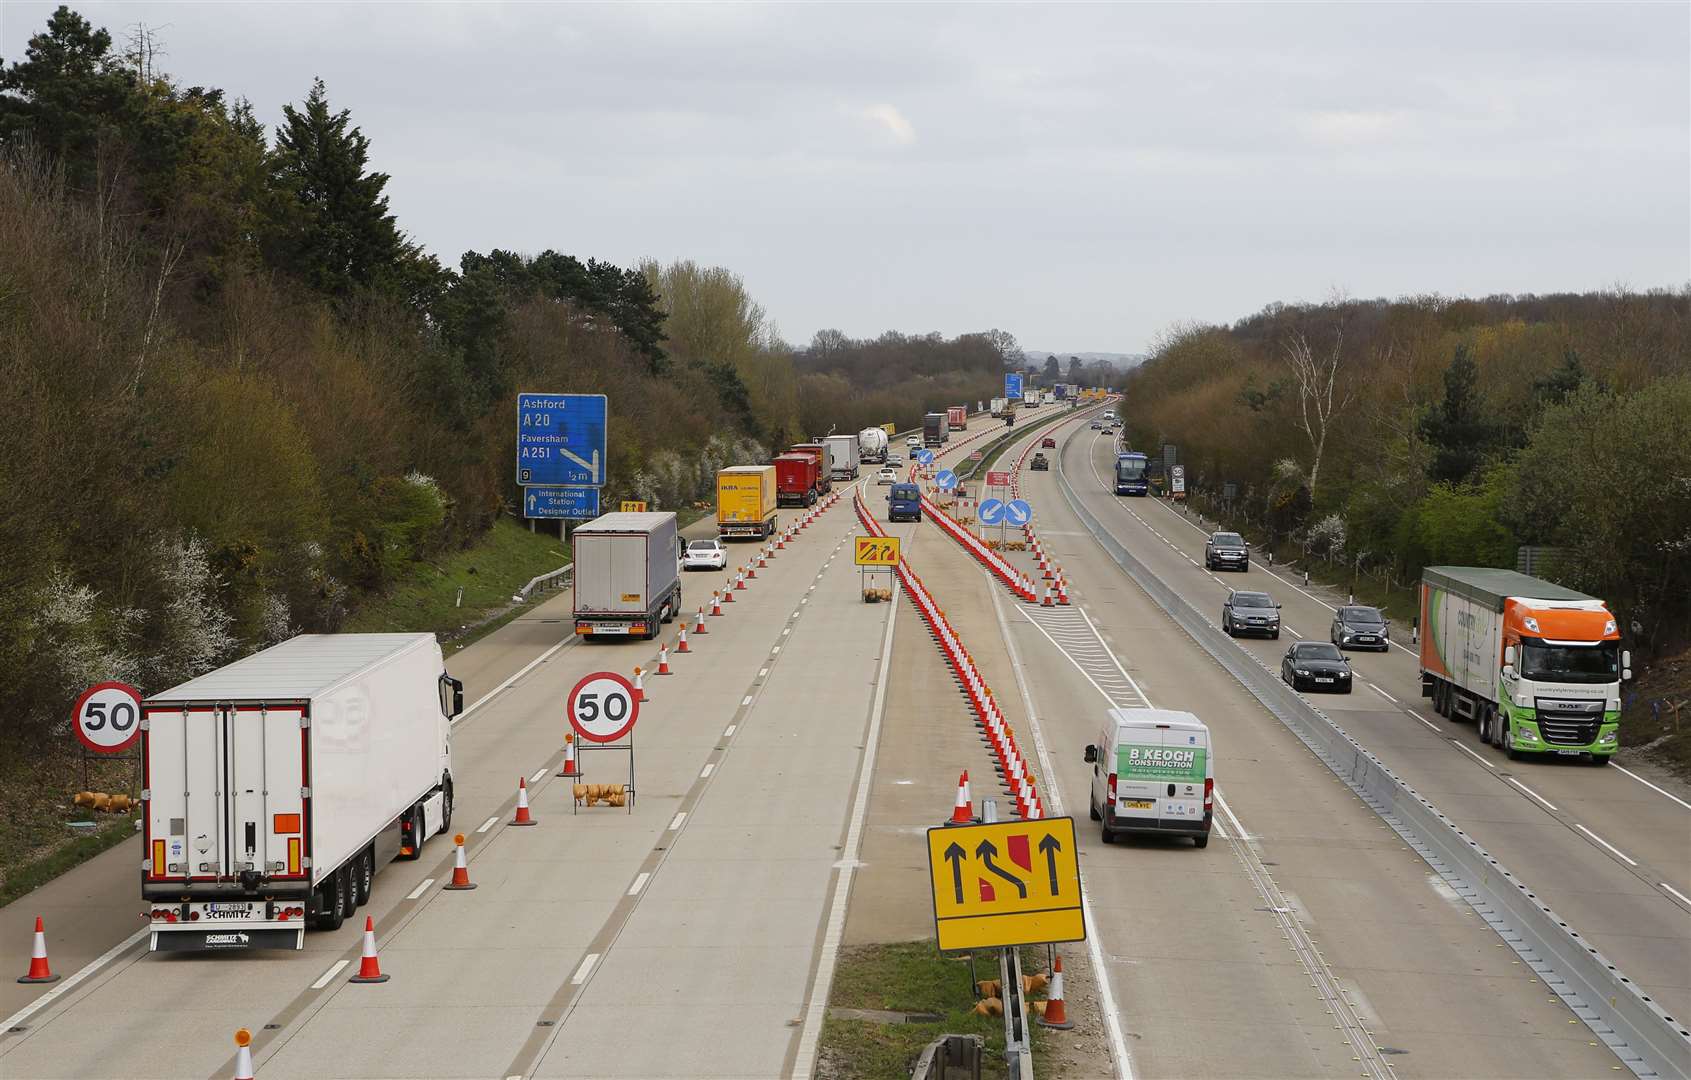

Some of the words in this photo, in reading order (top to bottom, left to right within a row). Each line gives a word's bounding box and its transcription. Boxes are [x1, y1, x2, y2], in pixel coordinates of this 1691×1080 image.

[523, 399, 565, 409] Ashford
[521, 434, 569, 443] Faversham
[522, 471, 529, 480] 9
[538, 490, 585, 498] International
[538, 507, 570, 516] Designer
[572, 508, 596, 516] Outlet
[579, 693, 627, 721] 50
[85, 702, 135, 731] 50
[1130, 748, 1140, 759] B
[1144, 749, 1195, 762] KEOGH
[1128, 759, 1193, 769] CONSTRUCTION
[205, 911, 251, 919] SCHMITZ
